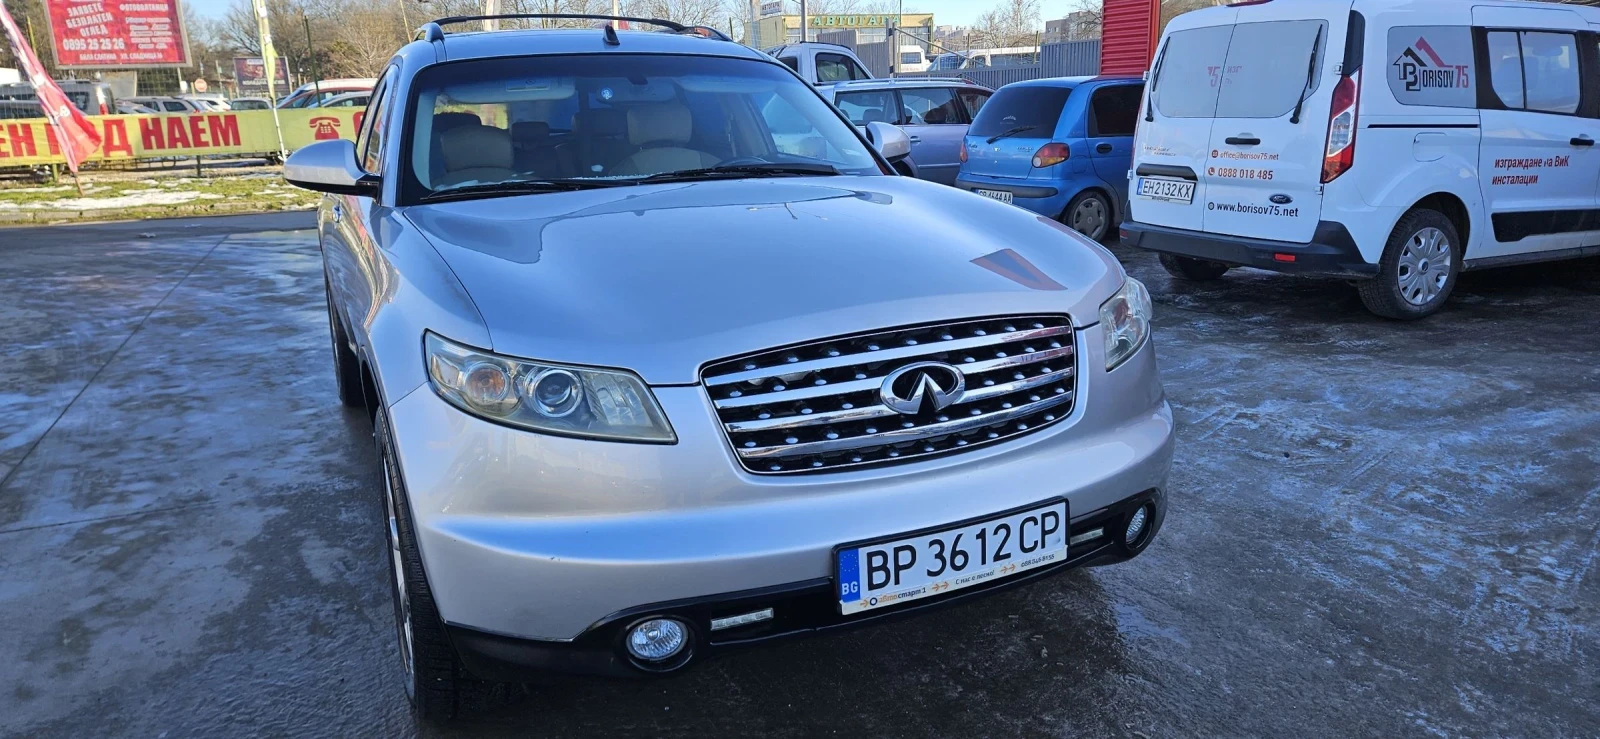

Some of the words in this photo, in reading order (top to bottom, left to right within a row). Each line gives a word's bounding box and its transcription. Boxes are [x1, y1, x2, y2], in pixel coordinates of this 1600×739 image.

[67, 3, 103, 17] ЗАЯВЕТЕ
[66, 12, 113, 28] БЕЗПЛАТЕН
[80, 24, 108, 37] ОГЛЕД
[63, 38, 87, 51] 0895
[87, 38, 99, 51] 25
[100, 38, 112, 50] 25
[112, 37, 125, 50] 26
[1455, 65, 1469, 88] 75
[138, 114, 241, 150] НАЕМ
[1220, 151, 1279, 160] office@borisov75.net
[1495, 158, 1543, 170] изграждане
[1554, 155, 1570, 167] ВиК
[1218, 167, 1237, 178] 0888
[1239, 169, 1255, 179] 018
[1257, 170, 1273, 180] 485
[1492, 175, 1538, 186] инсталации
[1216, 202, 1298, 217] www.borisov75.net
[927, 523, 1012, 577] 3612
[1019, 510, 1060, 553] CP
[842, 581, 858, 595] BG
